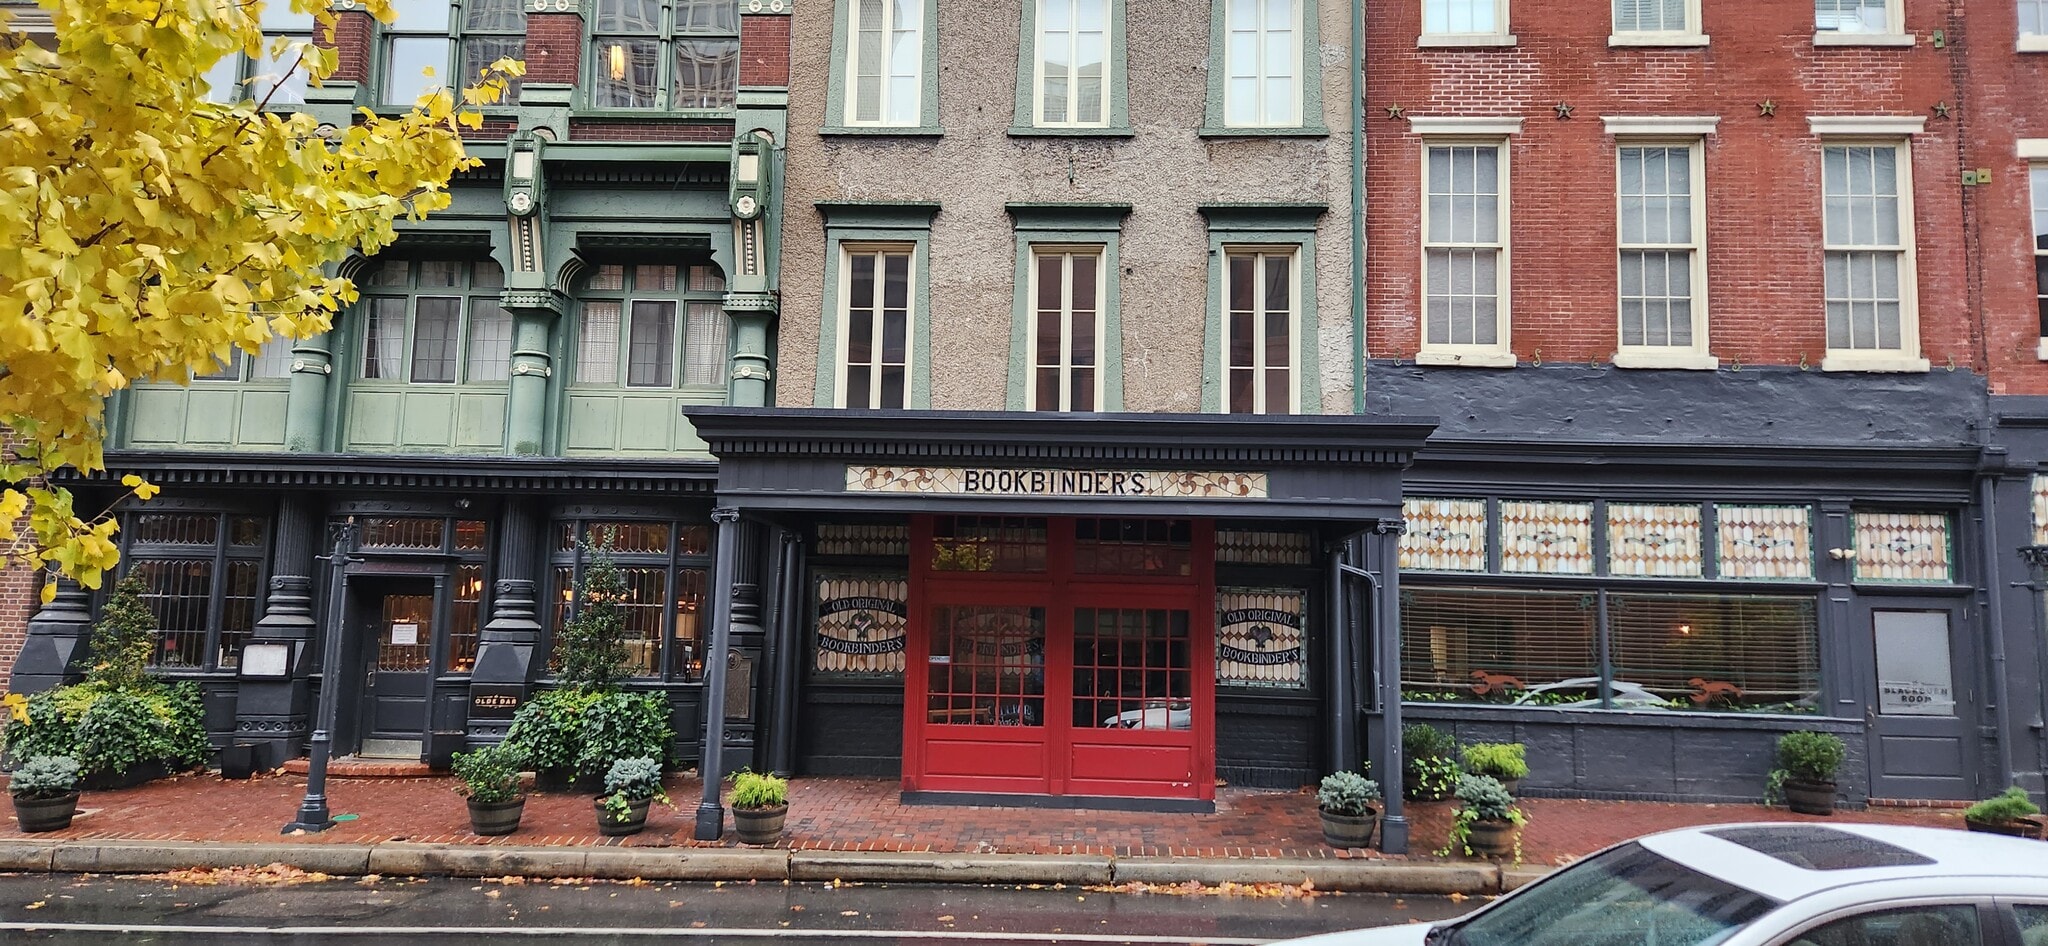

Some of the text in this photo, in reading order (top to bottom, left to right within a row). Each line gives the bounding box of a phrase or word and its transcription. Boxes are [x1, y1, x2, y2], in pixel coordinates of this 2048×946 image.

[831, 598, 896, 613] OLD ORIGINAL
[1227, 609, 1294, 626] OLD ORIGINAL
[1222, 646, 1298, 664] BOOKBINDER'S
